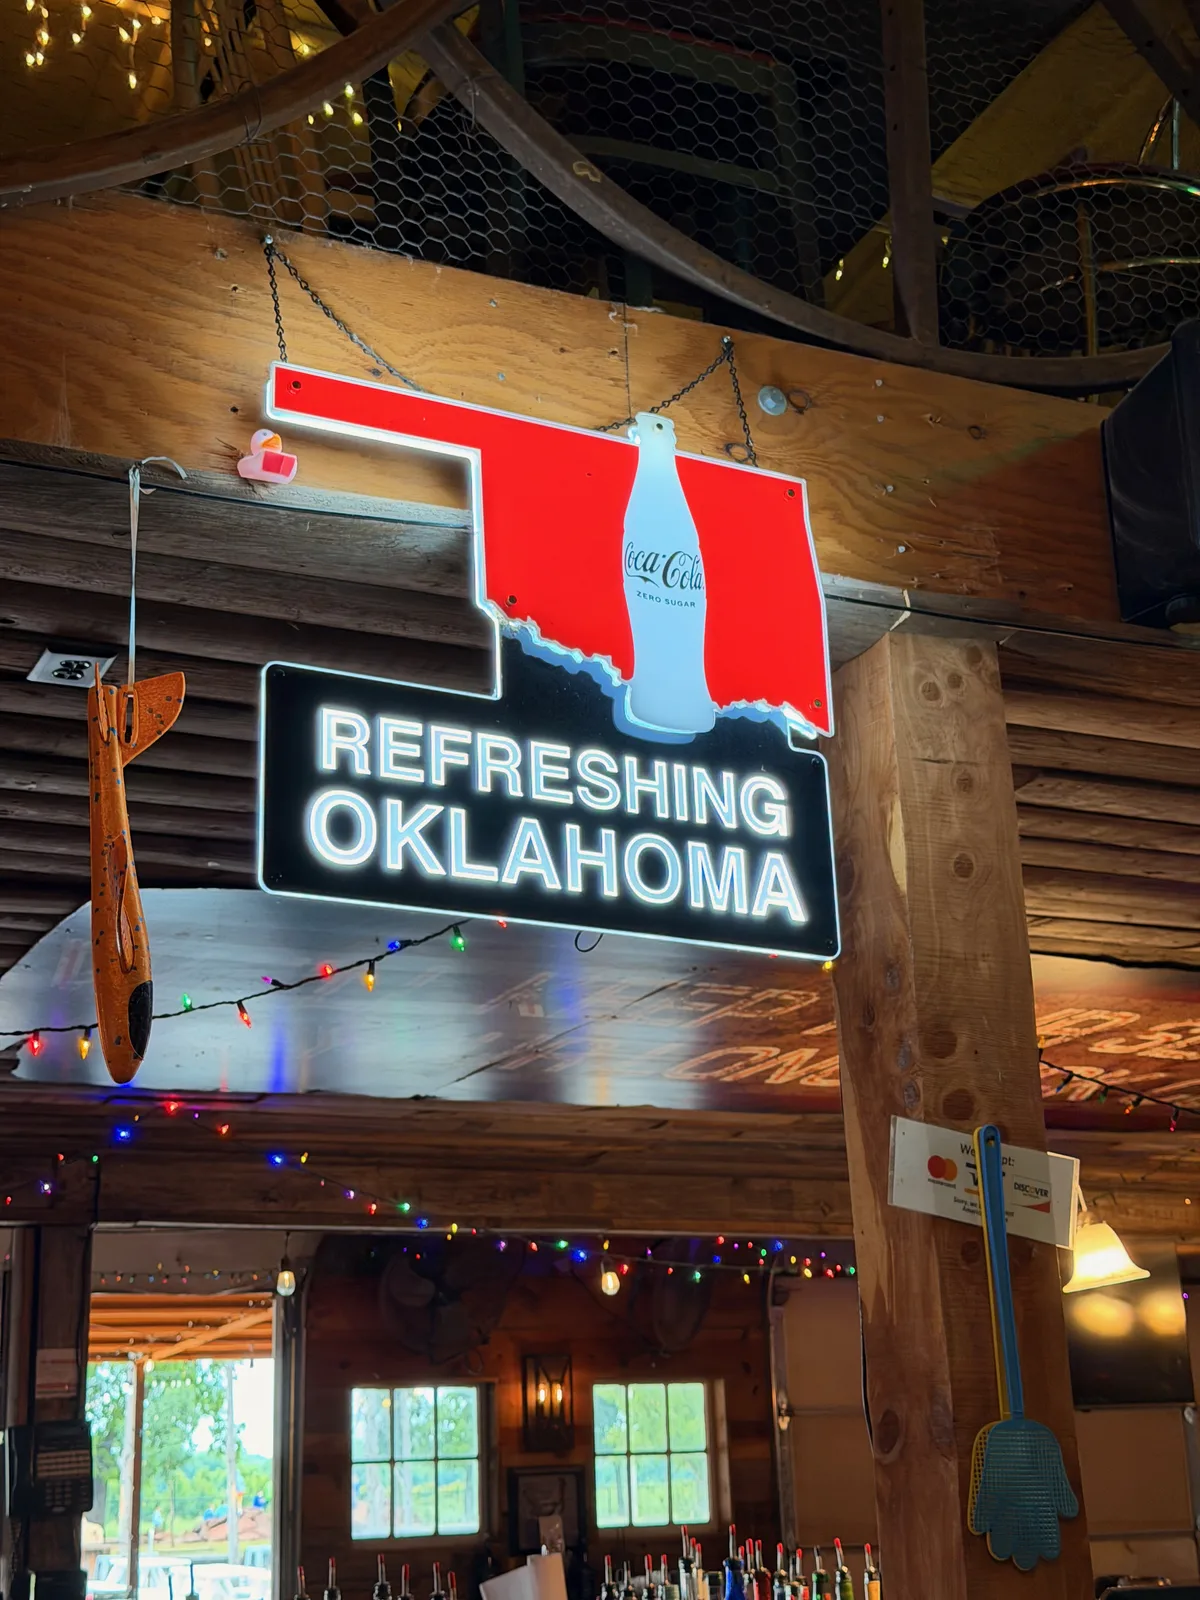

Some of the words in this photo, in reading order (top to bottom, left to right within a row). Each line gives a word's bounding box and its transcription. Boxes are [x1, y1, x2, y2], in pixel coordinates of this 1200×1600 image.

[624, 541, 704, 590] Coca-Cola
[636, 590, 661, 603] ZERO
[664, 598, 696, 608] SUGAR
[317, 706, 792, 838] REFRESHING
[306, 787, 808, 923] OKLAHOMA
[1013, 1182, 1049, 1198] DISCOVER
